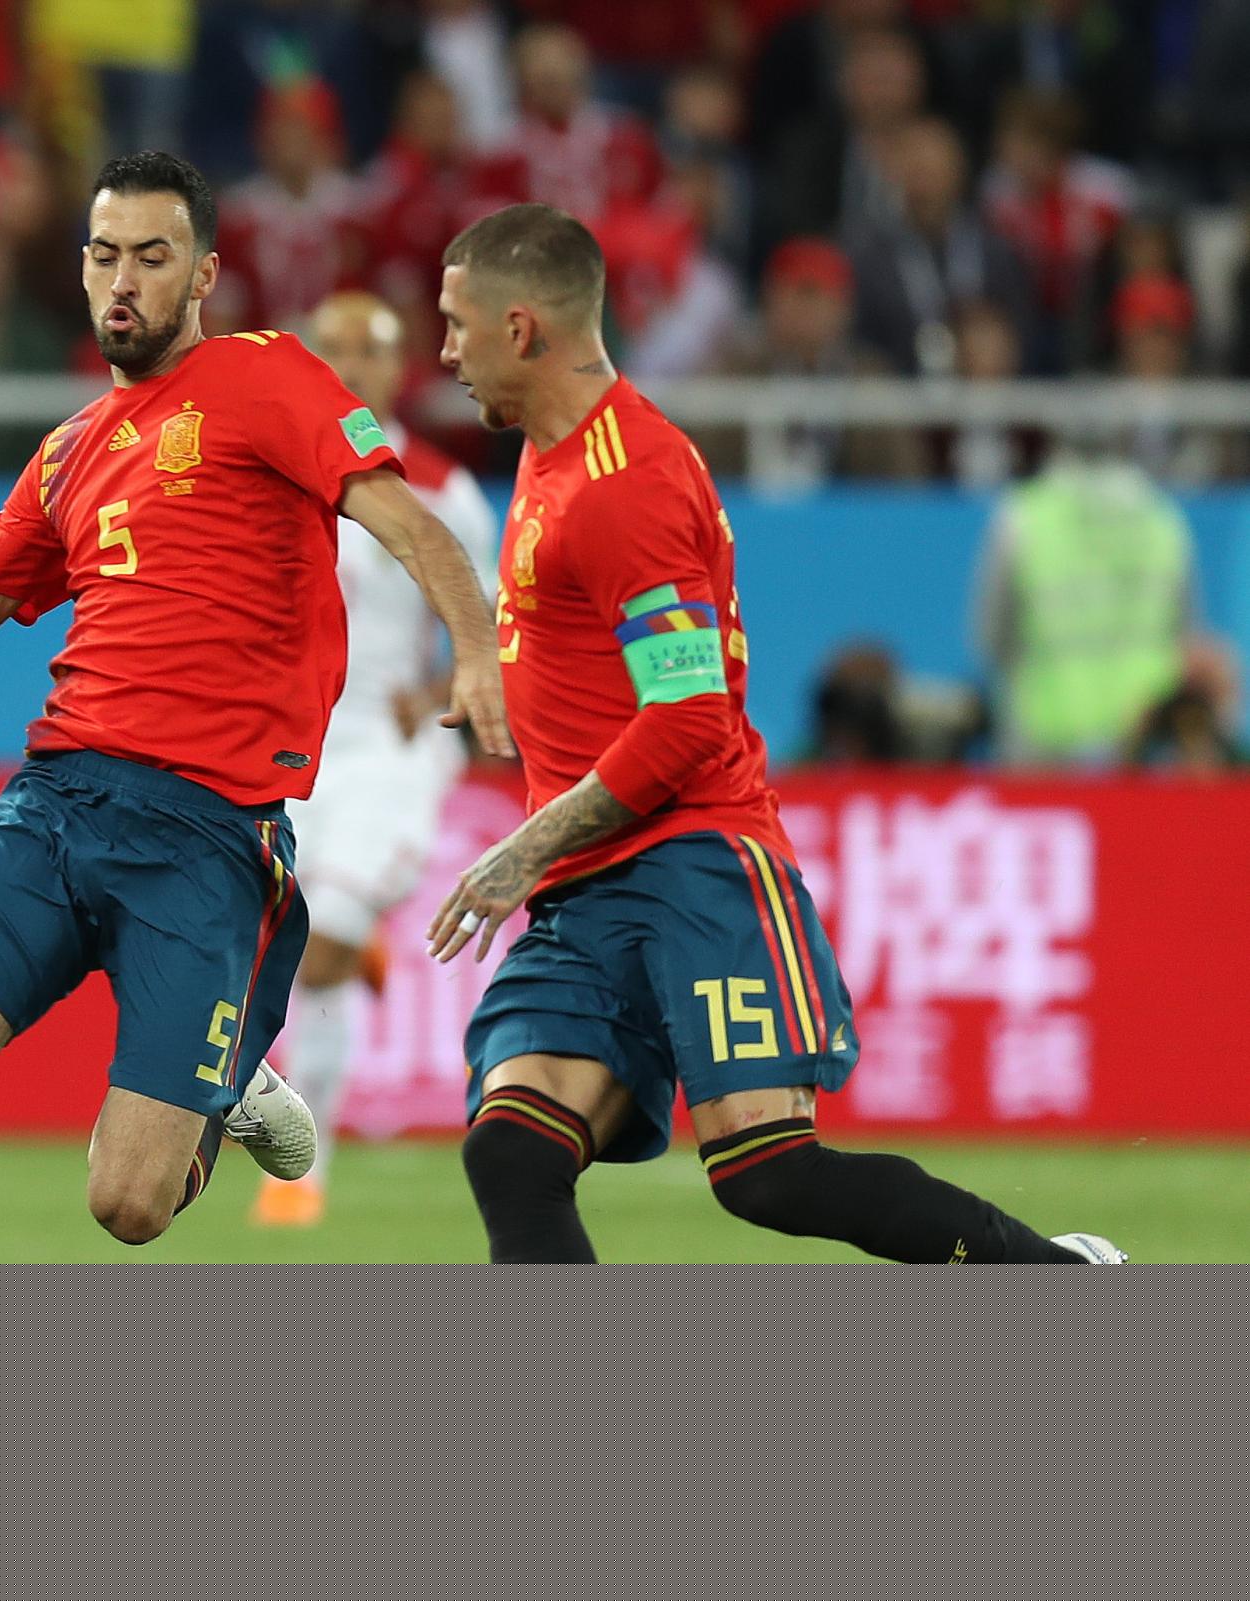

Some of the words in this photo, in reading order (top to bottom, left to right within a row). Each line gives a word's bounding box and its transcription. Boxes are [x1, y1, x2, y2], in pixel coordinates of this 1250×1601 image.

[98, 499, 139, 577] 5
[648, 642, 717, 661] LIVIN
[195, 1000, 238, 1087] 5
[694, 976, 780, 1063] 15
